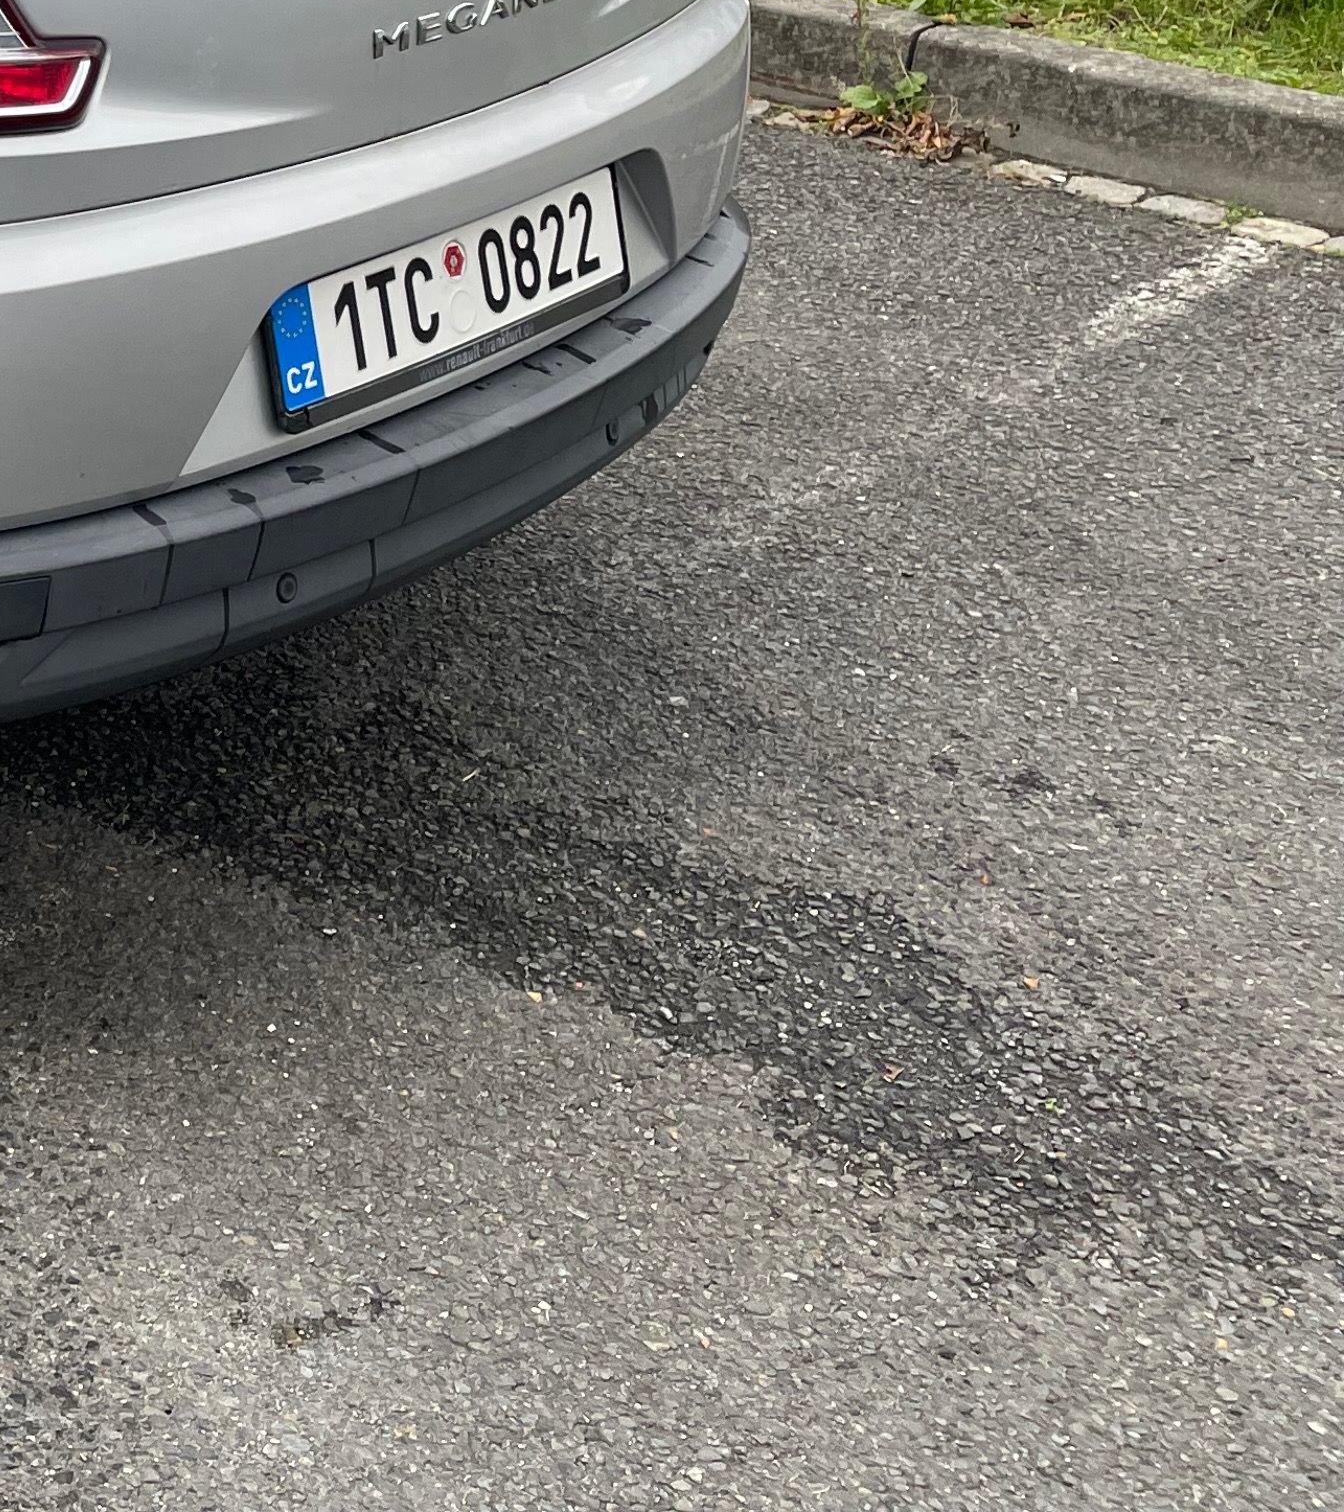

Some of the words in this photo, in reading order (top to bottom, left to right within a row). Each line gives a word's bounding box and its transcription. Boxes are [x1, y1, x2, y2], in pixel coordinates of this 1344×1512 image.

[334, 256, 440, 371] 1TC
[478, 191, 601, 314] 0822
[286, 361, 318, 394] CZ
